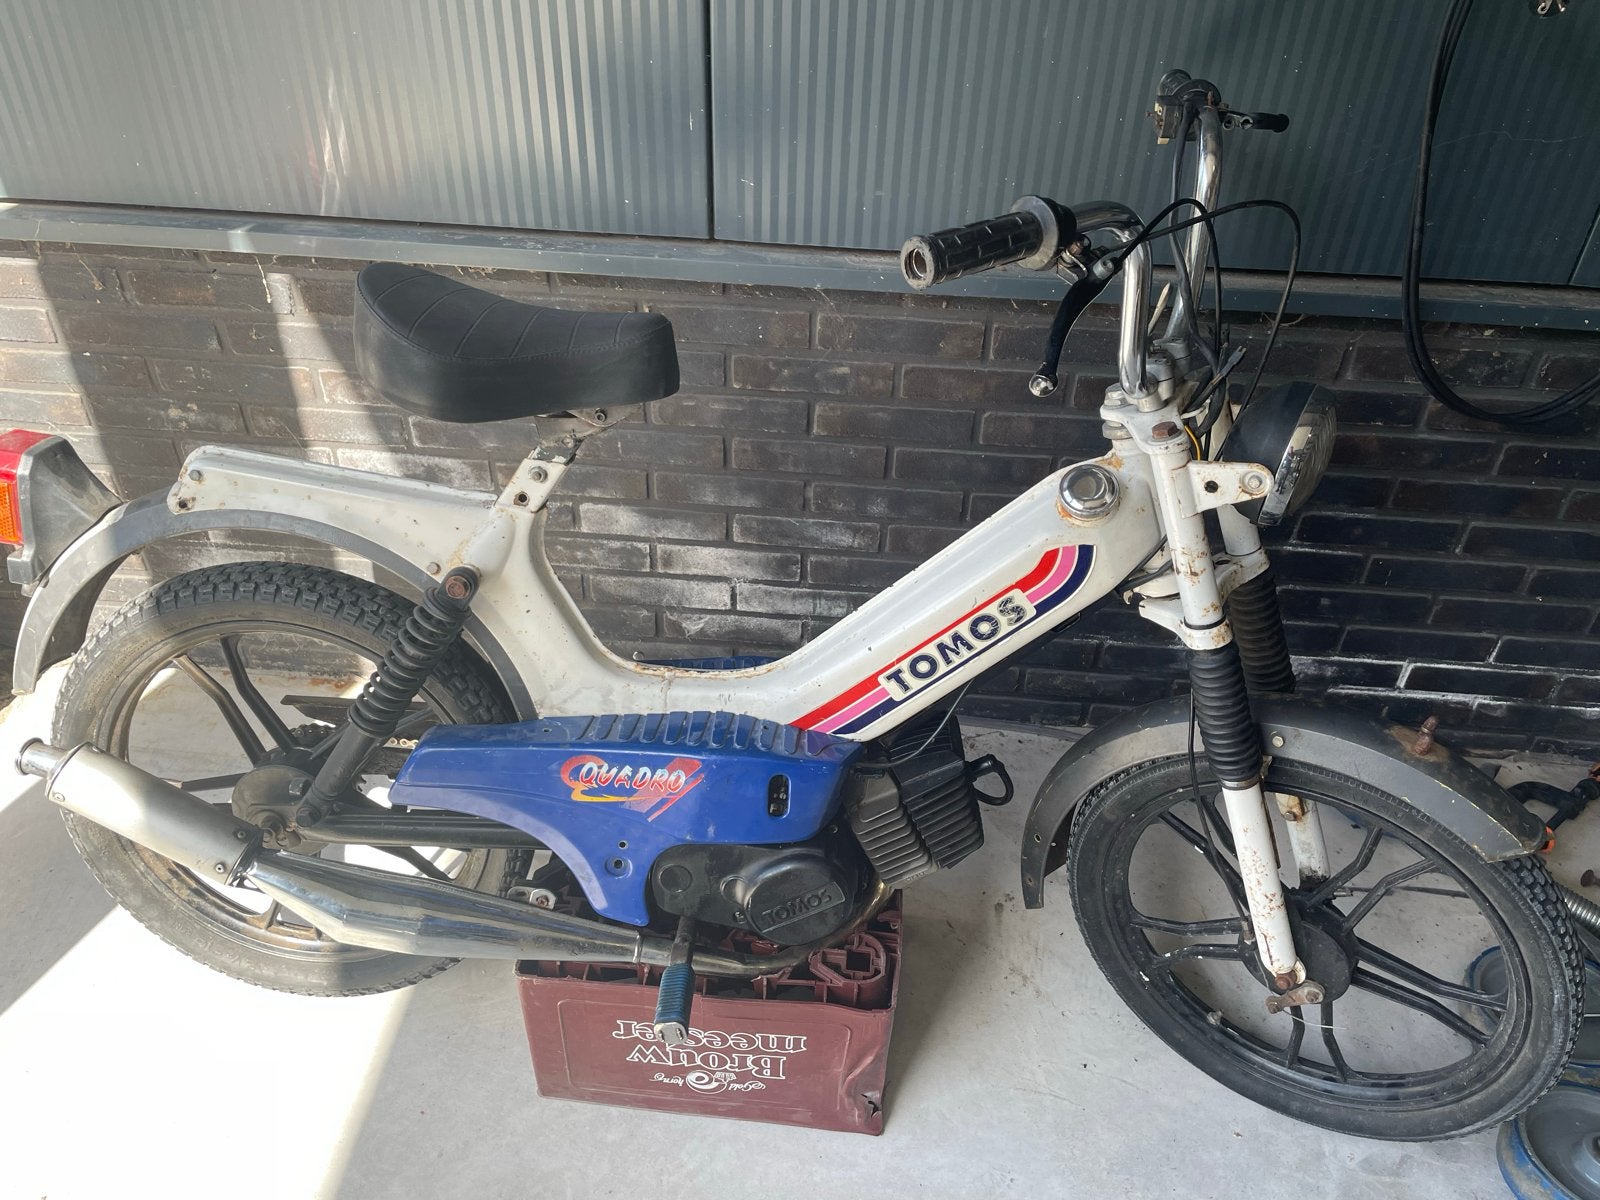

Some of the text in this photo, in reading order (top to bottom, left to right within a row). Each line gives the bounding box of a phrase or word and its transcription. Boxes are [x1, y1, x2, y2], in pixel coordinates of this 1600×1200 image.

[884, 595, 1028, 694] TOMOS
[578, 762, 687, 793] QUADRO
[761, 887, 834, 926] TOMOS
[612, 1019, 807, 1053] meeser
[627, 1043, 787, 1079] Brouw
[728, 1080, 766, 1092] Gold
